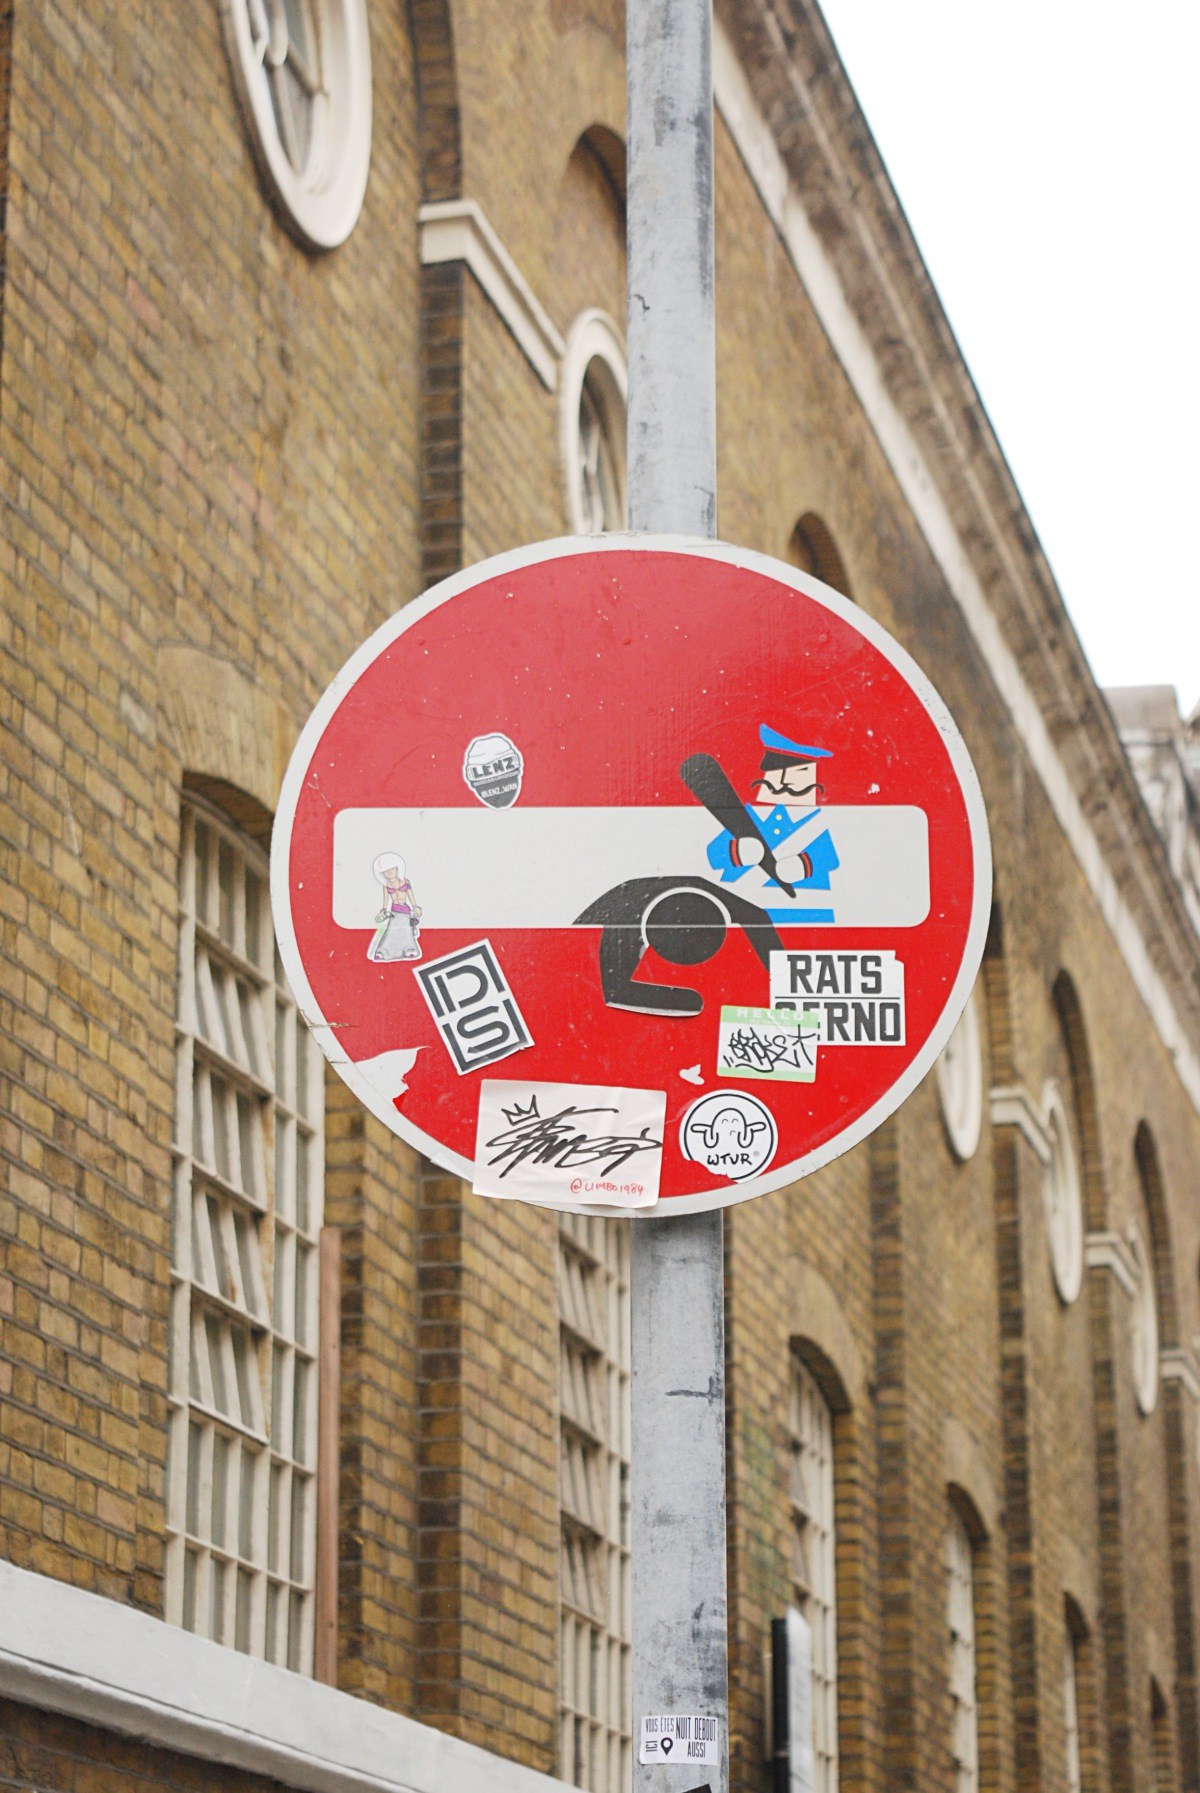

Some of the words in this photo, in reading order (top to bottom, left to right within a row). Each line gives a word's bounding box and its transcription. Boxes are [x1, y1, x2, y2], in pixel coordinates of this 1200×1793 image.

[472, 757, 515, 779] LENZ
[787, 954, 882, 994] RATS
[645, 1718, 658, 1733] VOUS
[676, 1717, 691, 1739] NUIT
[695, 1718, 716, 1741] DEBOUT
[687, 1742, 706, 1758] AUSSI
